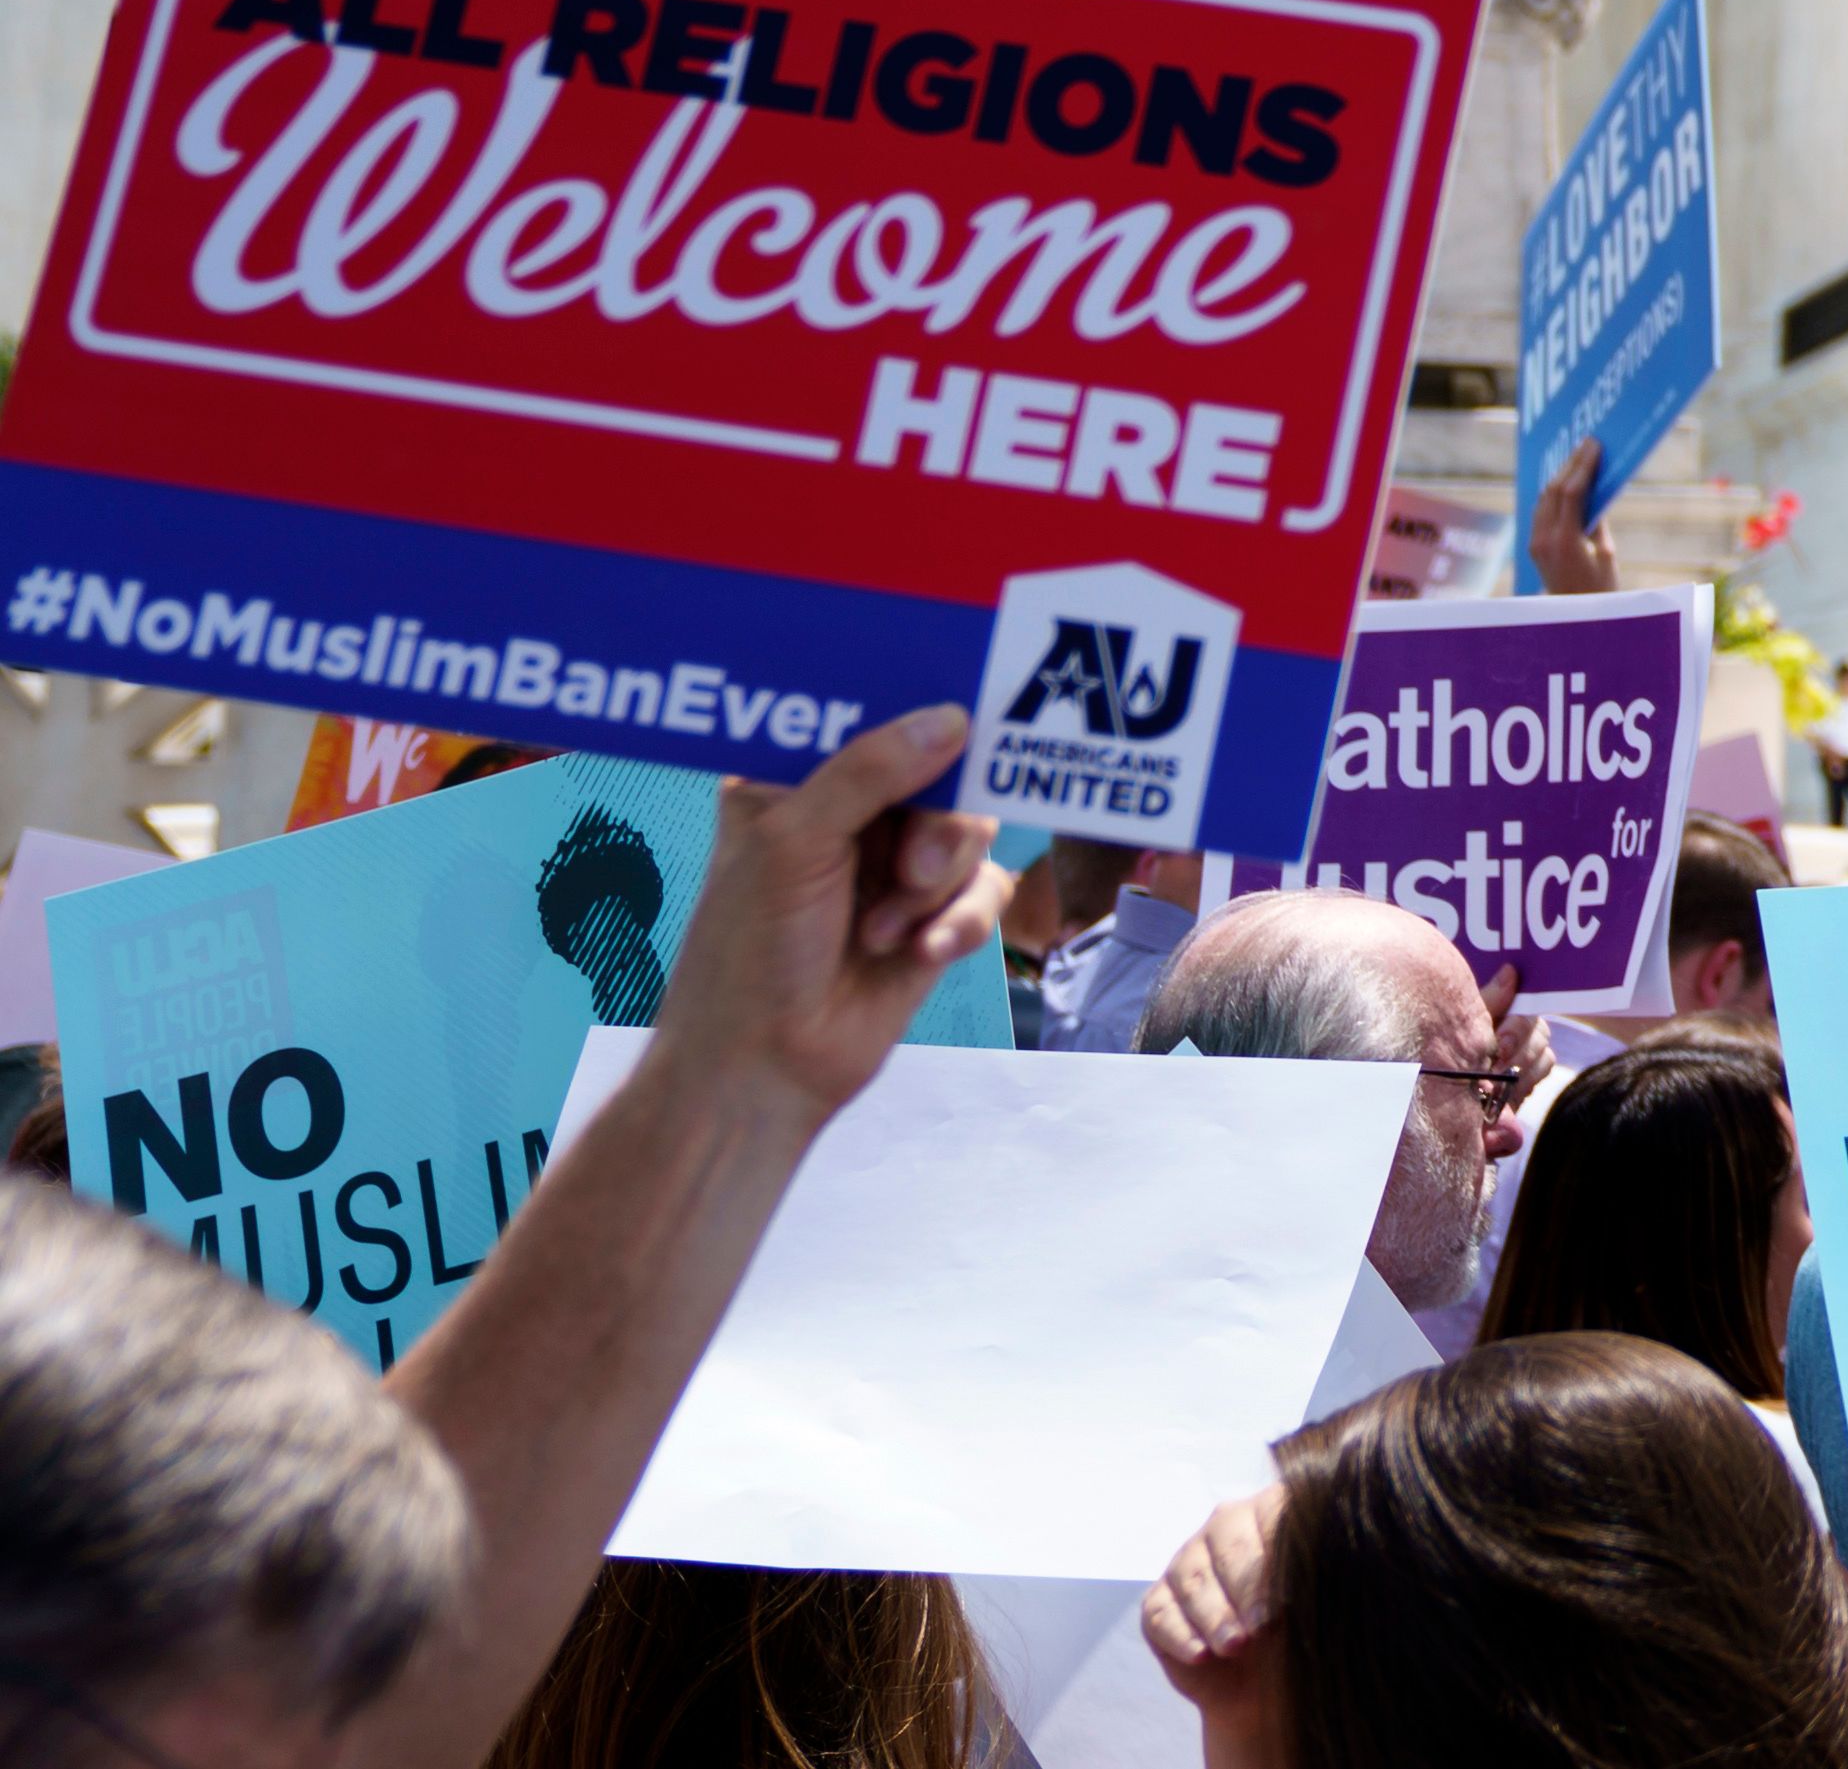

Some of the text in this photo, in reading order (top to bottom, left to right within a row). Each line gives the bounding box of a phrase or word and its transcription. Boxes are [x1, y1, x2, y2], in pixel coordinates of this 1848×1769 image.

[175, 20, 1309, 347] Welcome
[1521, 107, 1703, 434] NEIGHBOR
[856, 355, 1284, 526] HERE
[8, 566, 863, 752] #NoMuslimBanEver
[1327, 671, 1657, 792] atholics
[985, 759, 1173, 818] UNITED
[996, 734, 1181, 778] AMERICANS
[1611, 807, 1652, 859] for
[102, 1046, 346, 1216] NO
